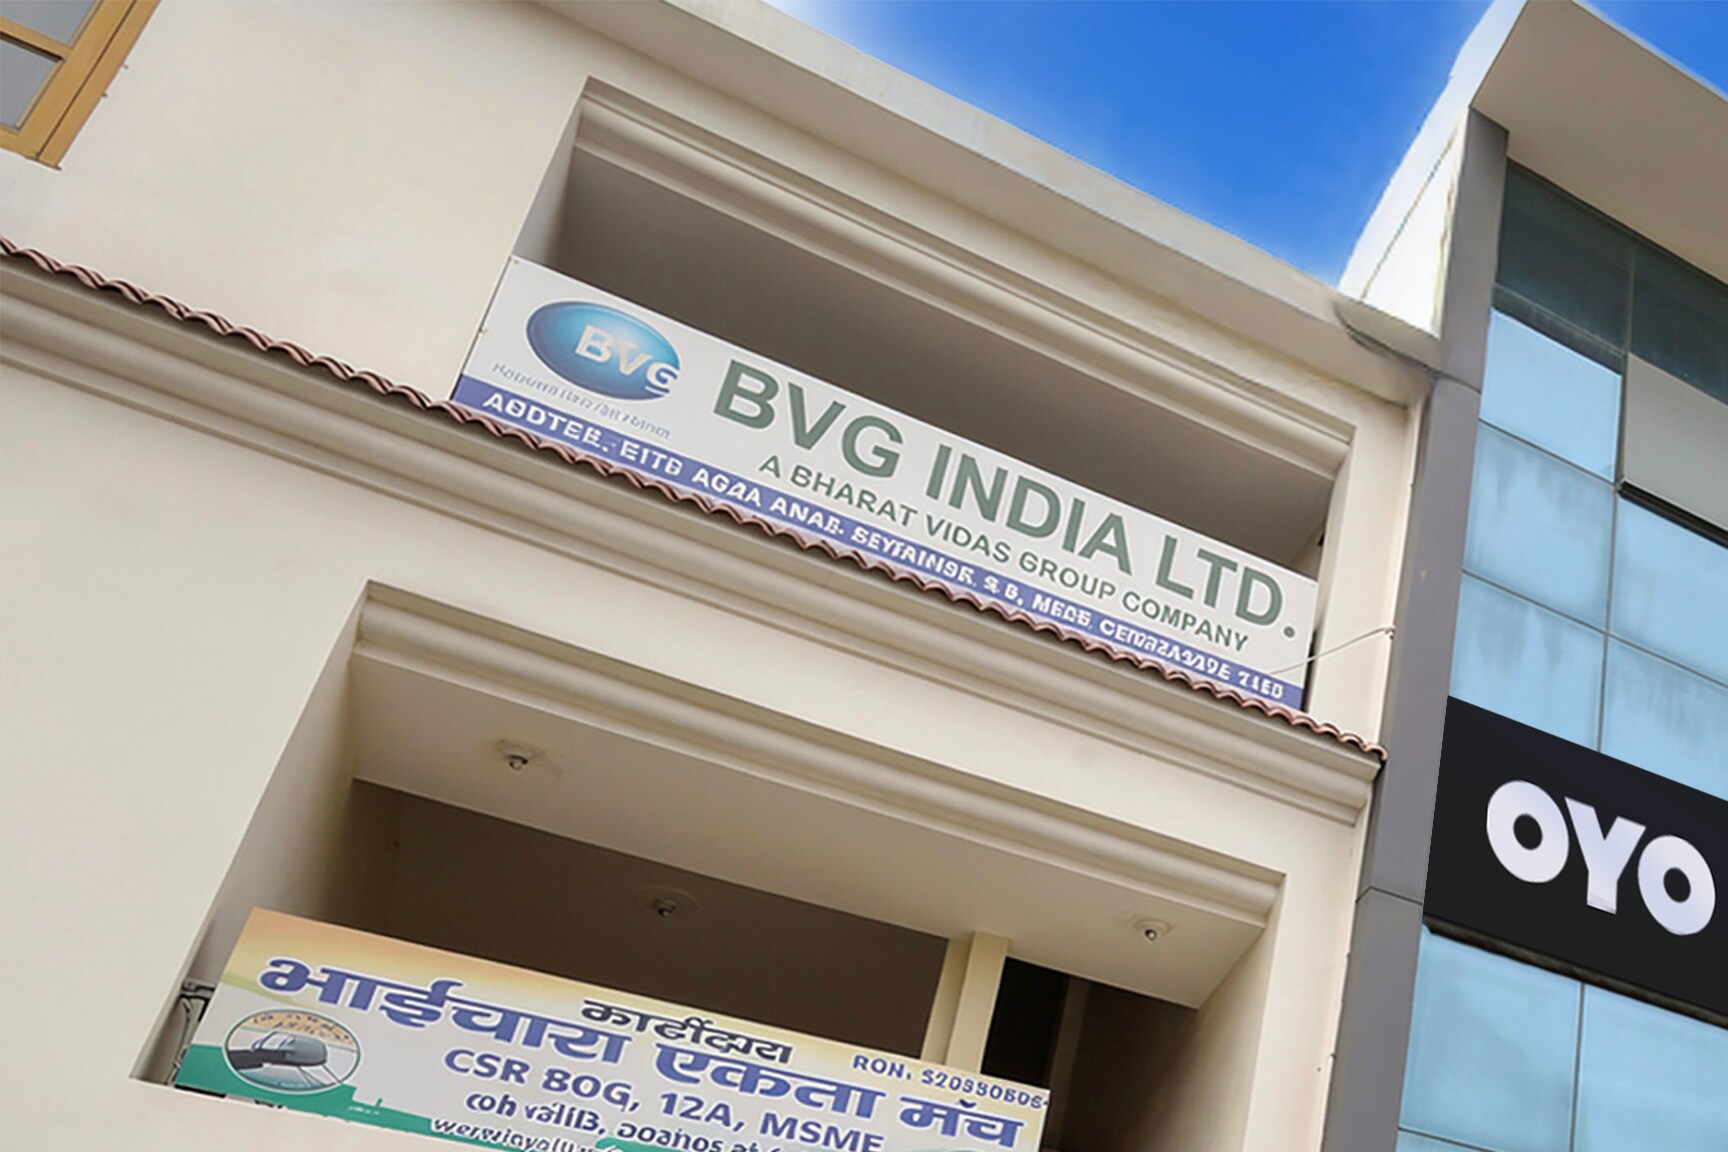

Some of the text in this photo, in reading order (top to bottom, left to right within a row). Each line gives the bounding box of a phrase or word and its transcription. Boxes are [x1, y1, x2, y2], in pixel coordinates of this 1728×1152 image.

[574, 325, 680, 388] BVG
[713, 359, 904, 478] BVG
[925, 443, 1132, 576] INDIA
[1155, 534, 1297, 640] LTD.
[758, 455, 781, 478] A
[790, 465, 918, 528] BHARAT
[926, 513, 1012, 565] VIDAS
[1018, 552, 1117, 602] GROUP
[1122, 590, 1250, 653] COMPANY
[1486, 779, 1716, 936] OYO
[443, 1048, 532, 1085] CSR
[658, 1091, 745, 1133] 12A,
[654, 1042, 888, 1119] एकता
